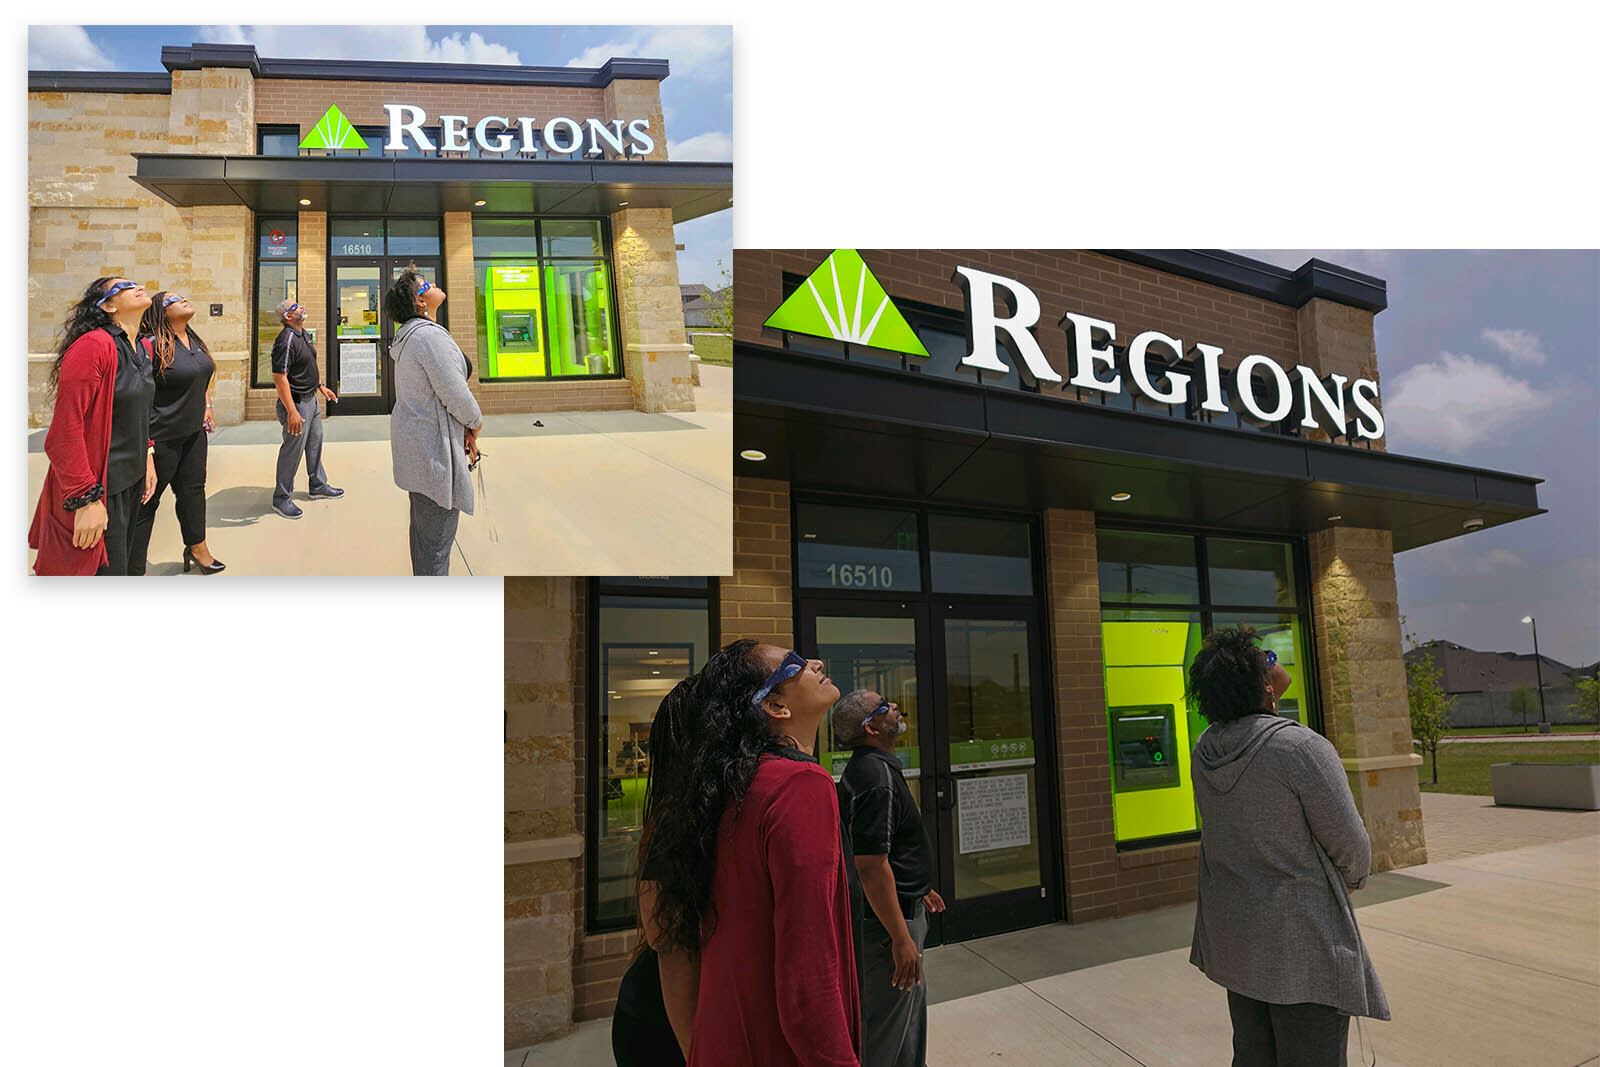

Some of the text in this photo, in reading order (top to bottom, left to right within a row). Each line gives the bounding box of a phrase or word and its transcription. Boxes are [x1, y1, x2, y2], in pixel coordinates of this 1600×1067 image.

[384, 104, 655, 154] REGIONS
[342, 244, 372, 255] 16510
[955, 265, 1385, 440] REGIONS
[827, 563, 893, 588] 16510
